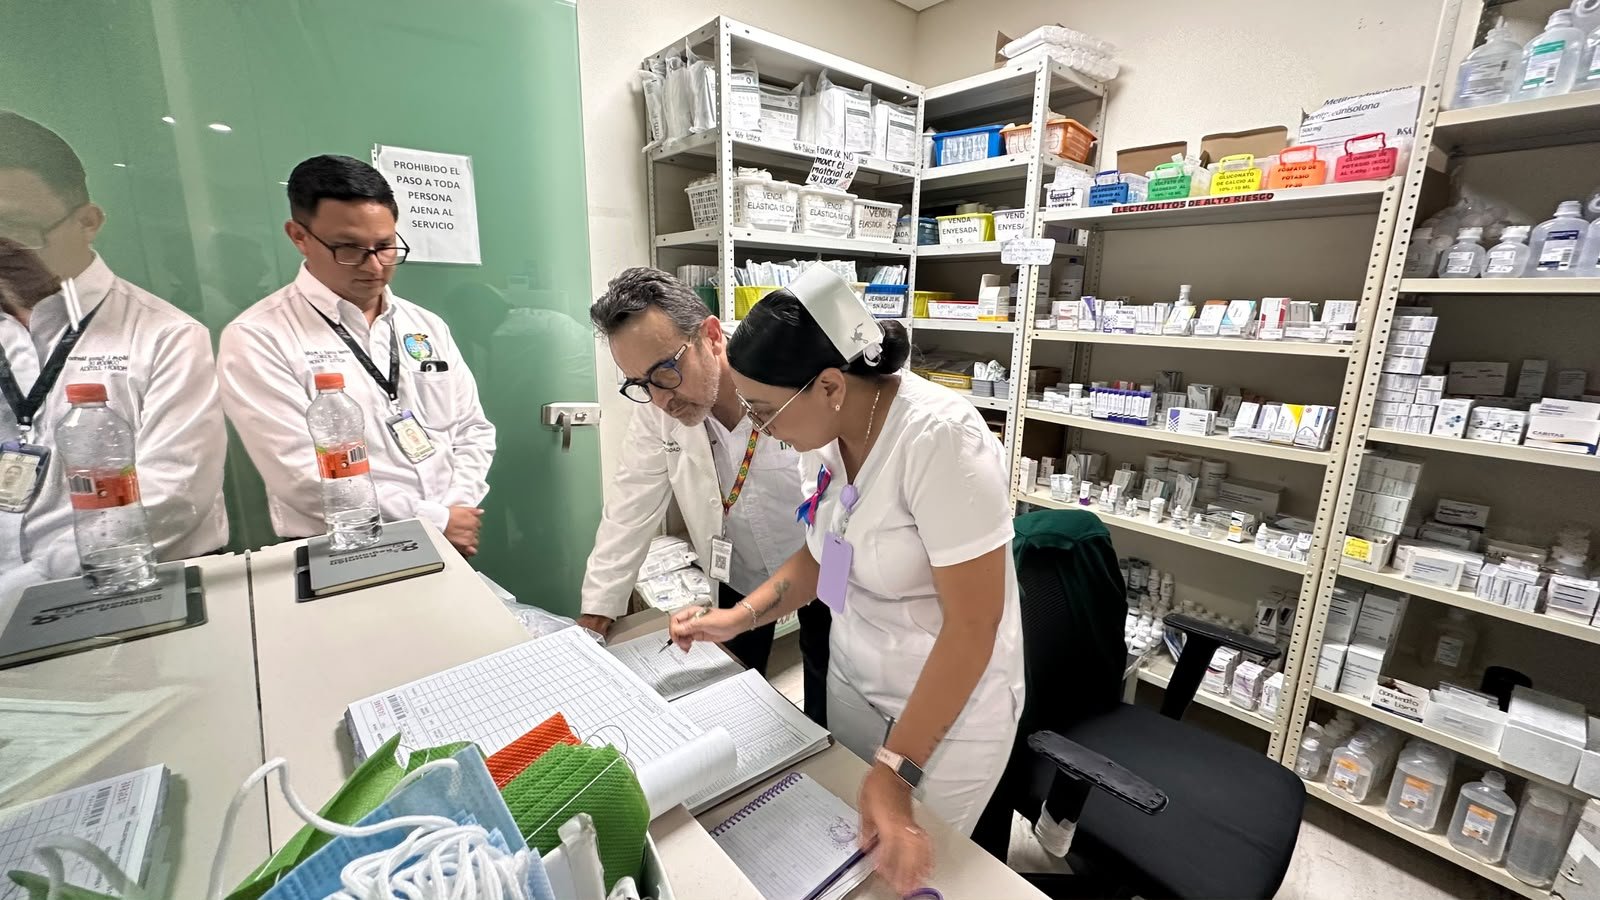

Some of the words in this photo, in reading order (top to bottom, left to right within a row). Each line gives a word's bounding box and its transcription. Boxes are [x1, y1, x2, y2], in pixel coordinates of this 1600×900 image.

[844, 152, 853, 161] NO
[393, 161, 448, 174] PROHIBIDO
[450, 167, 460, 175] EL
[1342, 161, 1370, 169] POTASIO
[812, 167, 843, 178] material
[845, 171, 853, 179] de
[1218, 172, 1254, 180] GLUCONATO
[396, 176, 422, 186] PASO
[425, 179, 432, 187] A
[434, 179, 460, 189] TODA
[810, 174, 819, 182] su
[408, 191, 452, 202] PERSONA
[762, 191, 782, 200] VENDA
[825, 202, 842, 210] VENDA
[1112, 200, 1186, 214] ELECTROLITOS
[1188, 199, 1201, 207] DE
[1204, 196, 1232, 206] ALTO
[1233, 192, 1275, 202] RIESGO
[410, 206, 440, 216] AJENA
[442, 208, 454, 216] AL
[869, 210, 892, 218] VENDA
[948, 216, 972, 224] VENDA
[1005, 212, 1024, 220] VEND
[412, 220, 454, 230] SERVICIO
